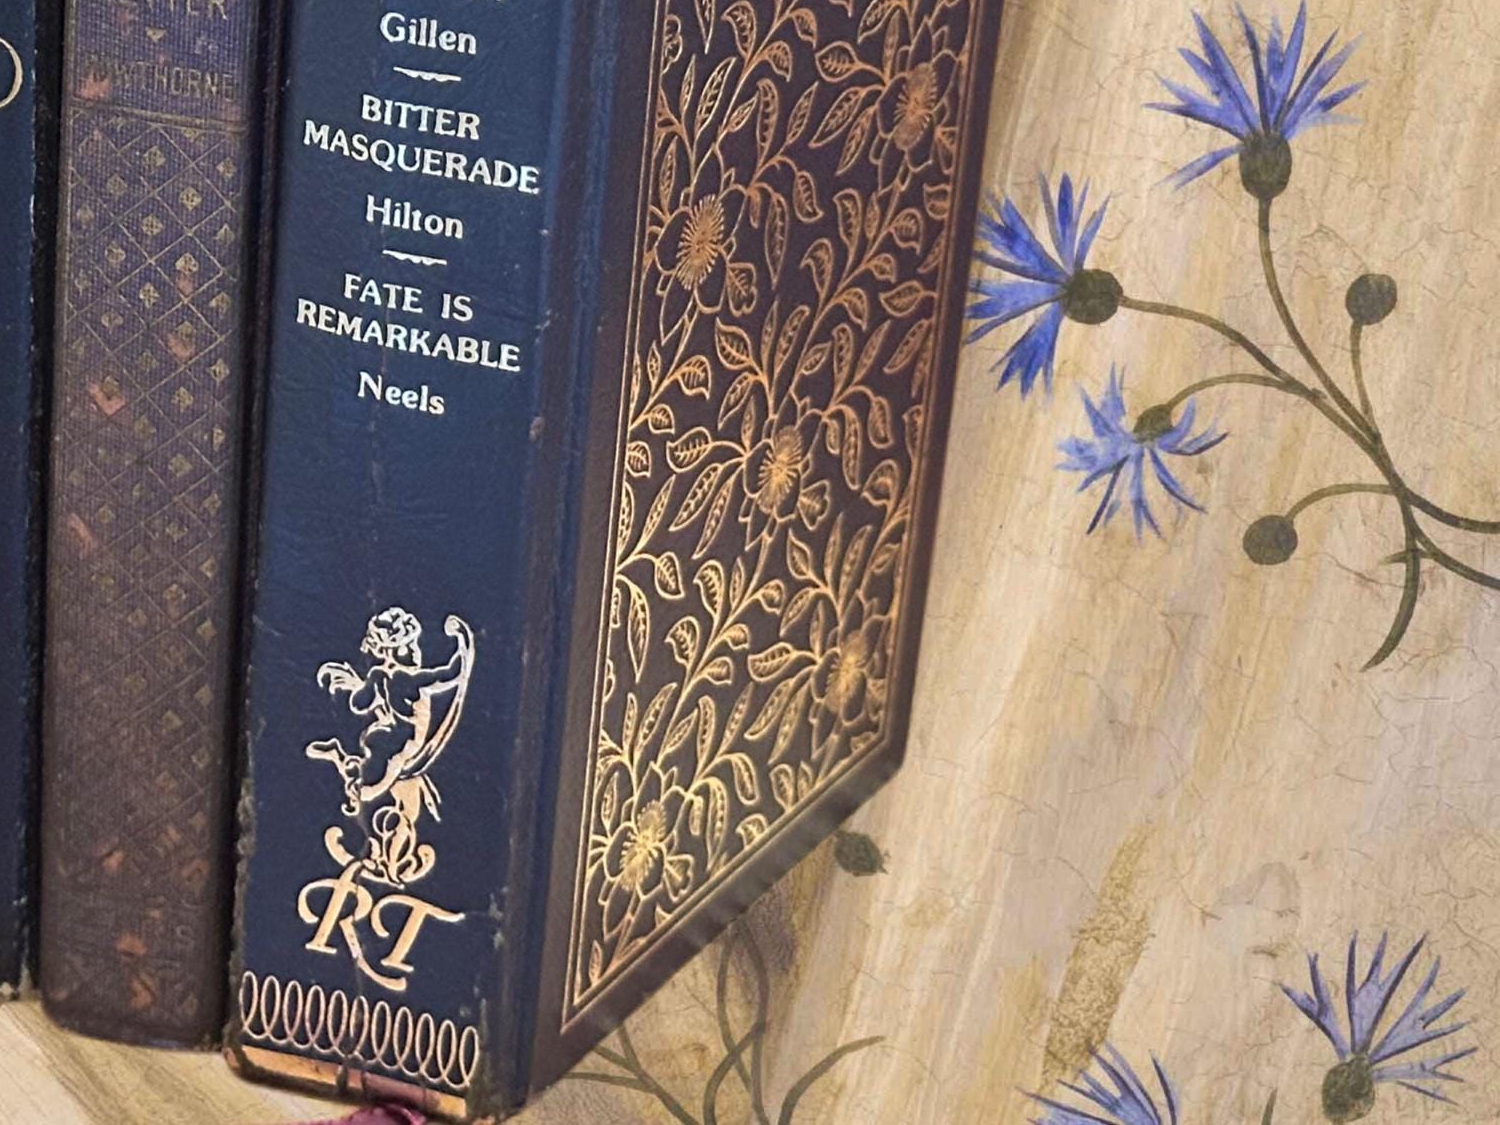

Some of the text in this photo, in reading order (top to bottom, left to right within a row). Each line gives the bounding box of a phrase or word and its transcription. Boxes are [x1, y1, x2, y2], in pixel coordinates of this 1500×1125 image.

[380, 12, 476, 54] Gillen
[86, 53, 235, 102] WTHORNE
[361, 94, 480, 140] BITTER
[303, 119, 540, 194] MASQUERADE
[366, 195, 463, 239] Hilton
[344, 274, 473, 322] FATE IS
[296, 298, 521, 372] REMARKABLE
[357, 372, 445, 415] Neels
[298, 861, 465, 991] RT
